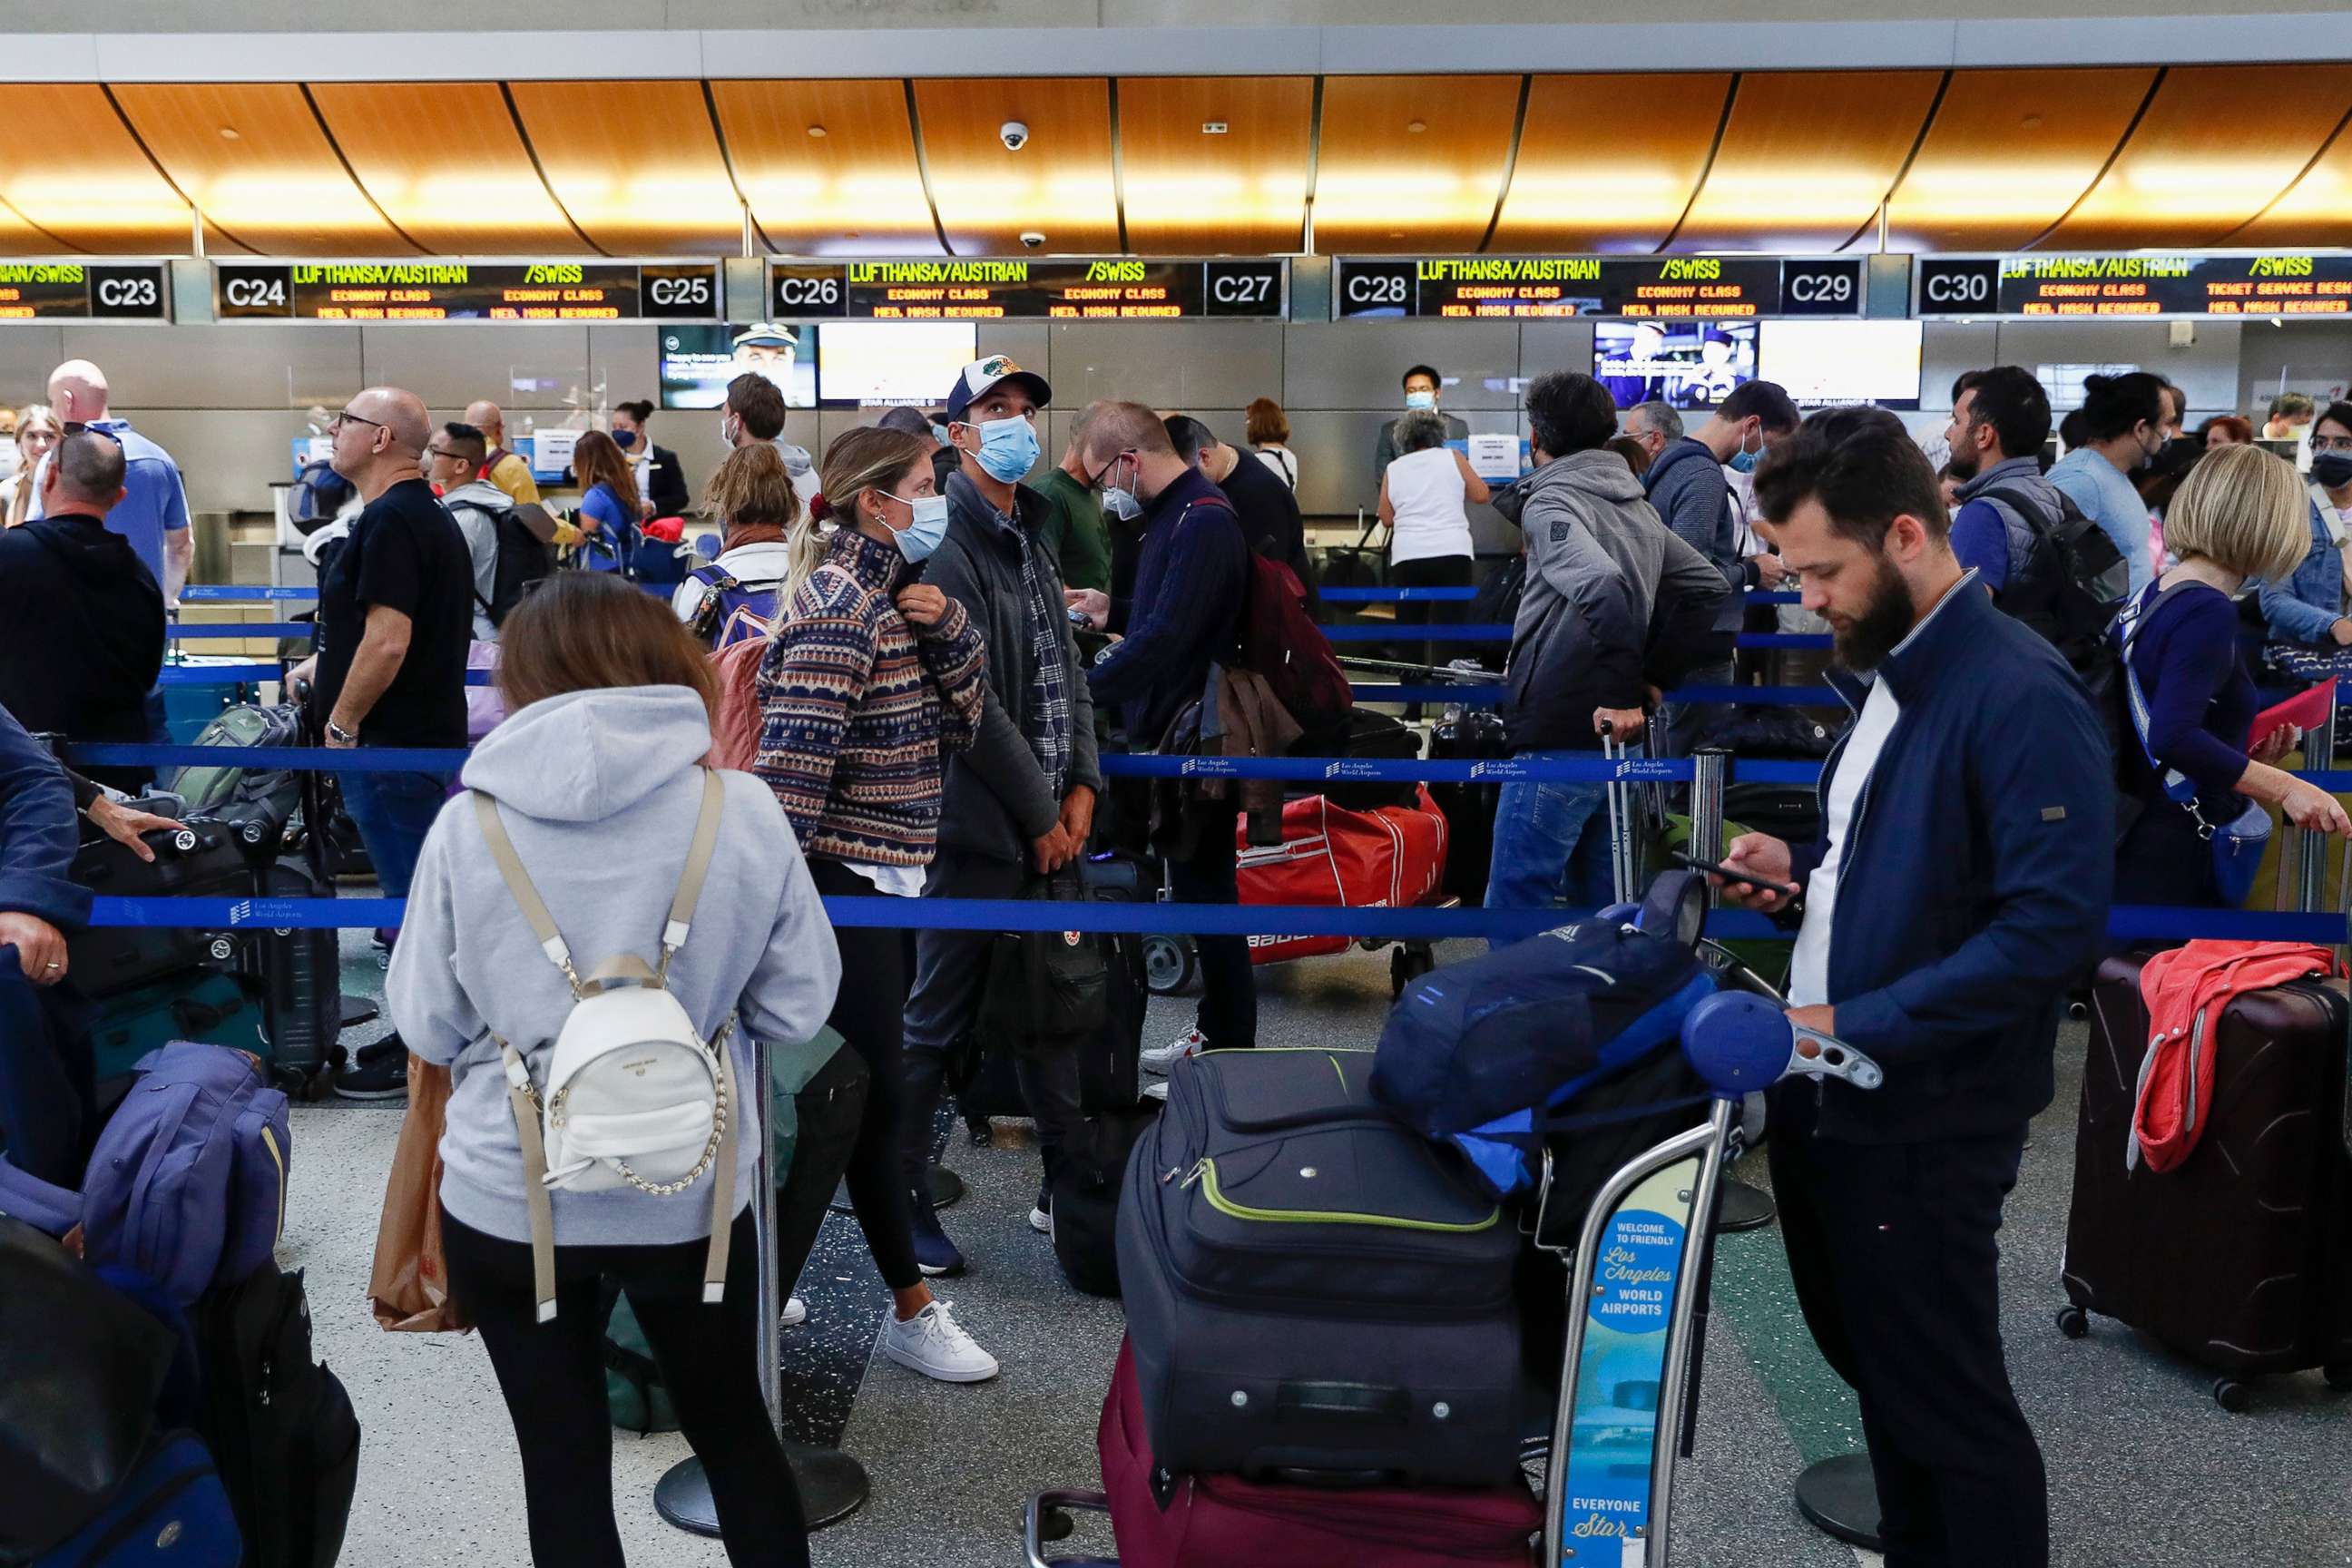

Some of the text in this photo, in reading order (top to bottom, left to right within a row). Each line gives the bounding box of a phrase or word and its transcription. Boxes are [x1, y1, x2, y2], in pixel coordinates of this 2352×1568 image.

[294, 264, 583, 284] LUFTHANSA/AUSTRIAN /SWISS
[848, 261, 1145, 282] LUFTHANSA/AUSTRIAN /SWISS
[1418, 259, 1720, 280] LUFTHANSA/AUSTRIAN /SWISS
[2002, 257, 2313, 279] LUFTHANSA/AUSTRIAN /SWISS
[100, 279, 157, 306] C23
[227, 279, 286, 306] C24
[652, 278, 709, 304] C25
[780, 278, 838, 304] C26
[887, 288, 989, 300] ECONOMY CLASS
[1064, 288, 1166, 300] ECONOMY CLASS
[1214, 276, 1272, 302] C27
[1348, 276, 1406, 302] C28
[1456, 287, 1561, 299] ECONOMY CLASS
[1637, 286, 1741, 299] ECONOMY CLASS
[1791, 274, 1851, 301] C29
[1928, 274, 1987, 301] C30
[2039, 283, 2146, 297] ECONOMY CLASS
[2207, 283, 2253, 296] TICKET
[2257, 282, 2313, 295] SERVICE
[330, 289, 431, 302] ECONOMY CLASS
[504, 289, 603, 302] ECONOMY CLASS
[317, 308, 446, 319] MED. MASK REQUIRED
[490, 308, 619, 319] MED. MASK REQUIRED
[873, 307, 1004, 318] MED. MASK REQUIRED
[1050, 307, 1181, 318] MED. MASK REQUIRED
[1442, 305, 1574, 317] MED. MASK REQUIRED
[1622, 305, 1756, 317] MED. MASK REQUIRED
[2023, 302, 2161, 315] MED. MASK REQUIRED
[2208, 301, 2348, 313] MED. MASK REQUIRED
[1617, 1223, 1664, 1234] WELCOME
[1617, 1234, 1674, 1246] TO FRIENDLY
[1602, 1246, 1636, 1267] Los
[1605, 1265, 1671, 1286] Angeles
[1619, 1289, 1662, 1301] WORLD
[1601, 1302, 1661, 1316] AIRPORTS
[1573, 1498, 1641, 1513] EVERYONE
[1571, 1513, 1627, 1538] Star
